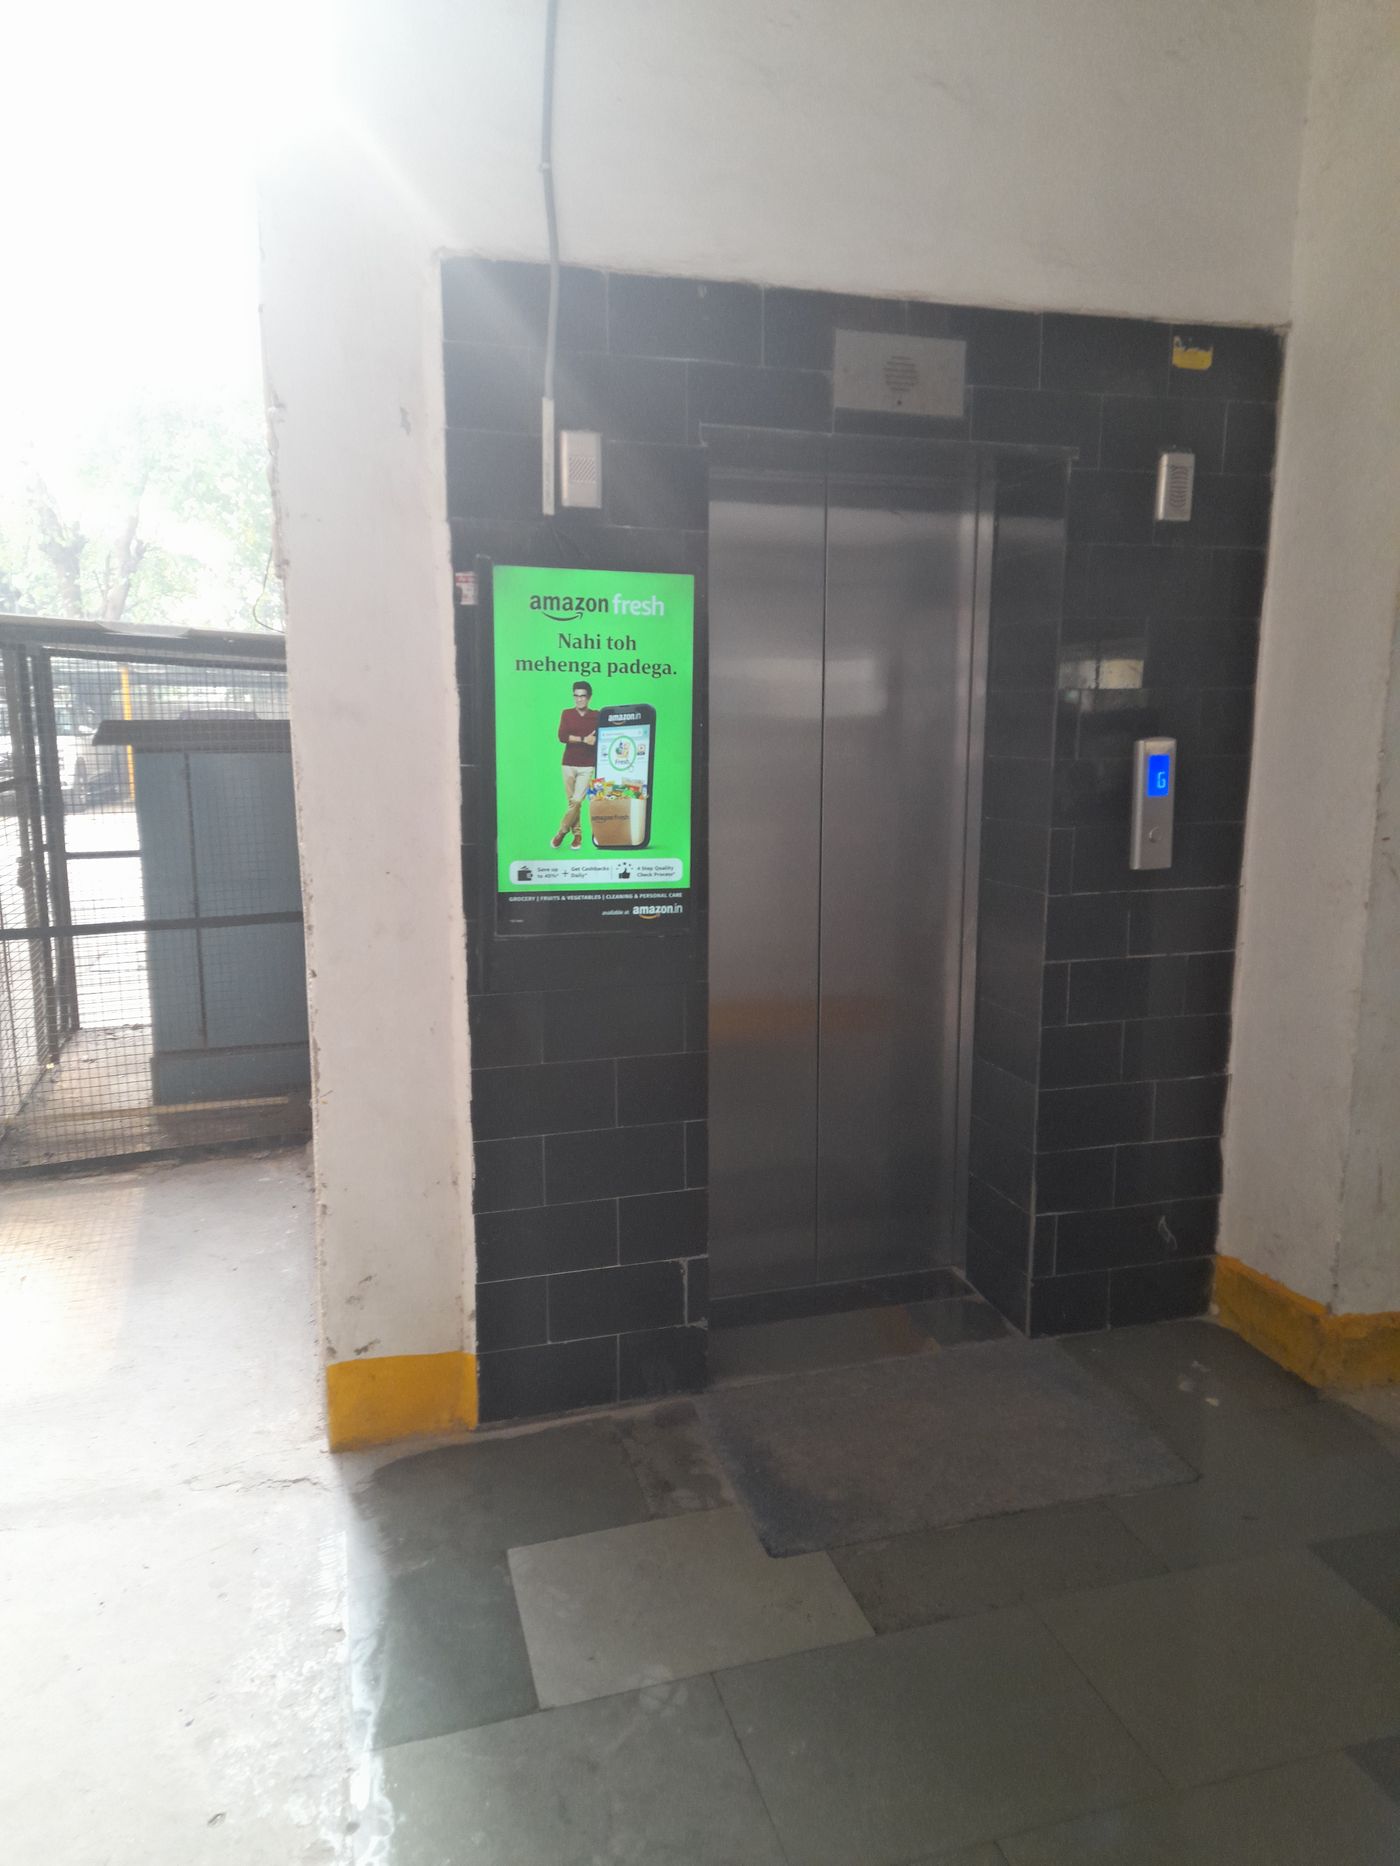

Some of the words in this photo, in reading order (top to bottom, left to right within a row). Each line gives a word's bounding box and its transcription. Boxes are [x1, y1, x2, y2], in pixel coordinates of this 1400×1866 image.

[529, 594, 609, 613] amazon
[613, 593, 665, 616] fresh
[558, 632, 601, 650] Nahi
[607, 635, 636, 651] toh
[515, 656, 601, 676] mehenga
[607, 659, 678, 679] padega.
[1156, 771, 1166, 789] G
[632, 903, 683, 915] amazon.in
